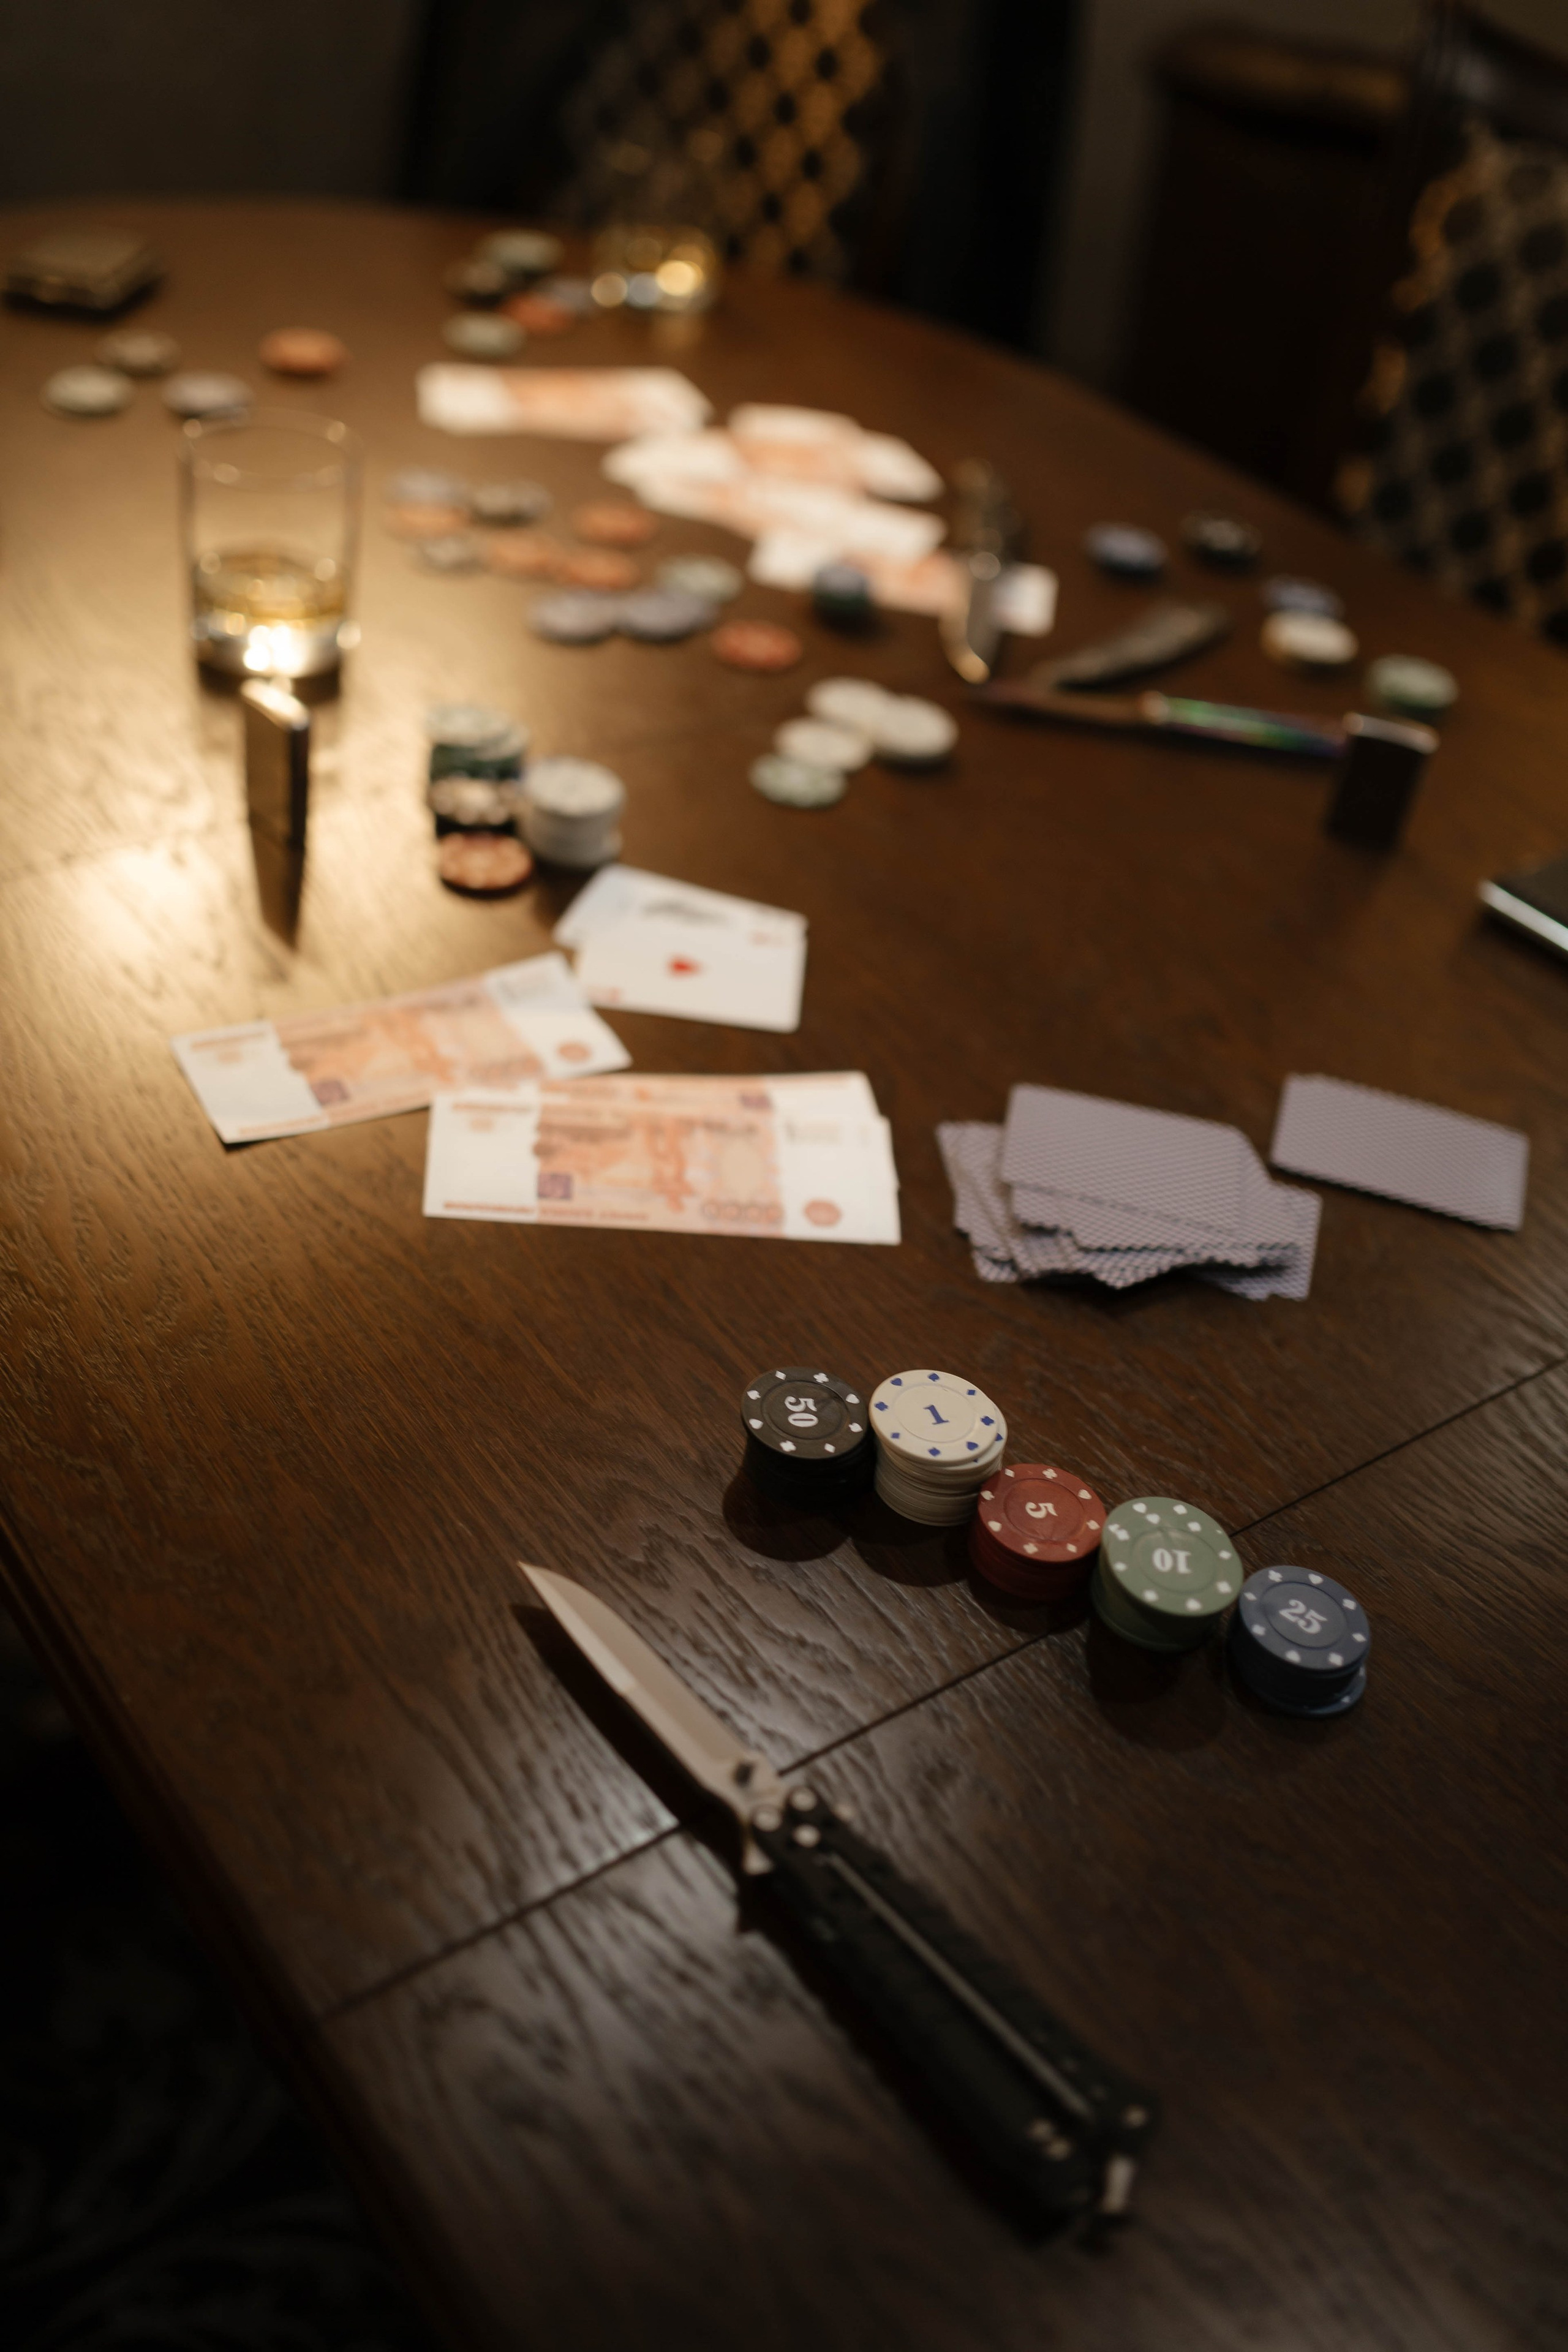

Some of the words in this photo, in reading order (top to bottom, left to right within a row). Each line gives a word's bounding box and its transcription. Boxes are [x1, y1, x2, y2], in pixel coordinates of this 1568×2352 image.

[785, 1396, 818, 1427] 50
[923, 1404, 949, 1425] 1
[1025, 1502, 1058, 1519] 5
[1152, 1548, 1192, 1574] 10
[1279, 1599, 1327, 1634] 25
